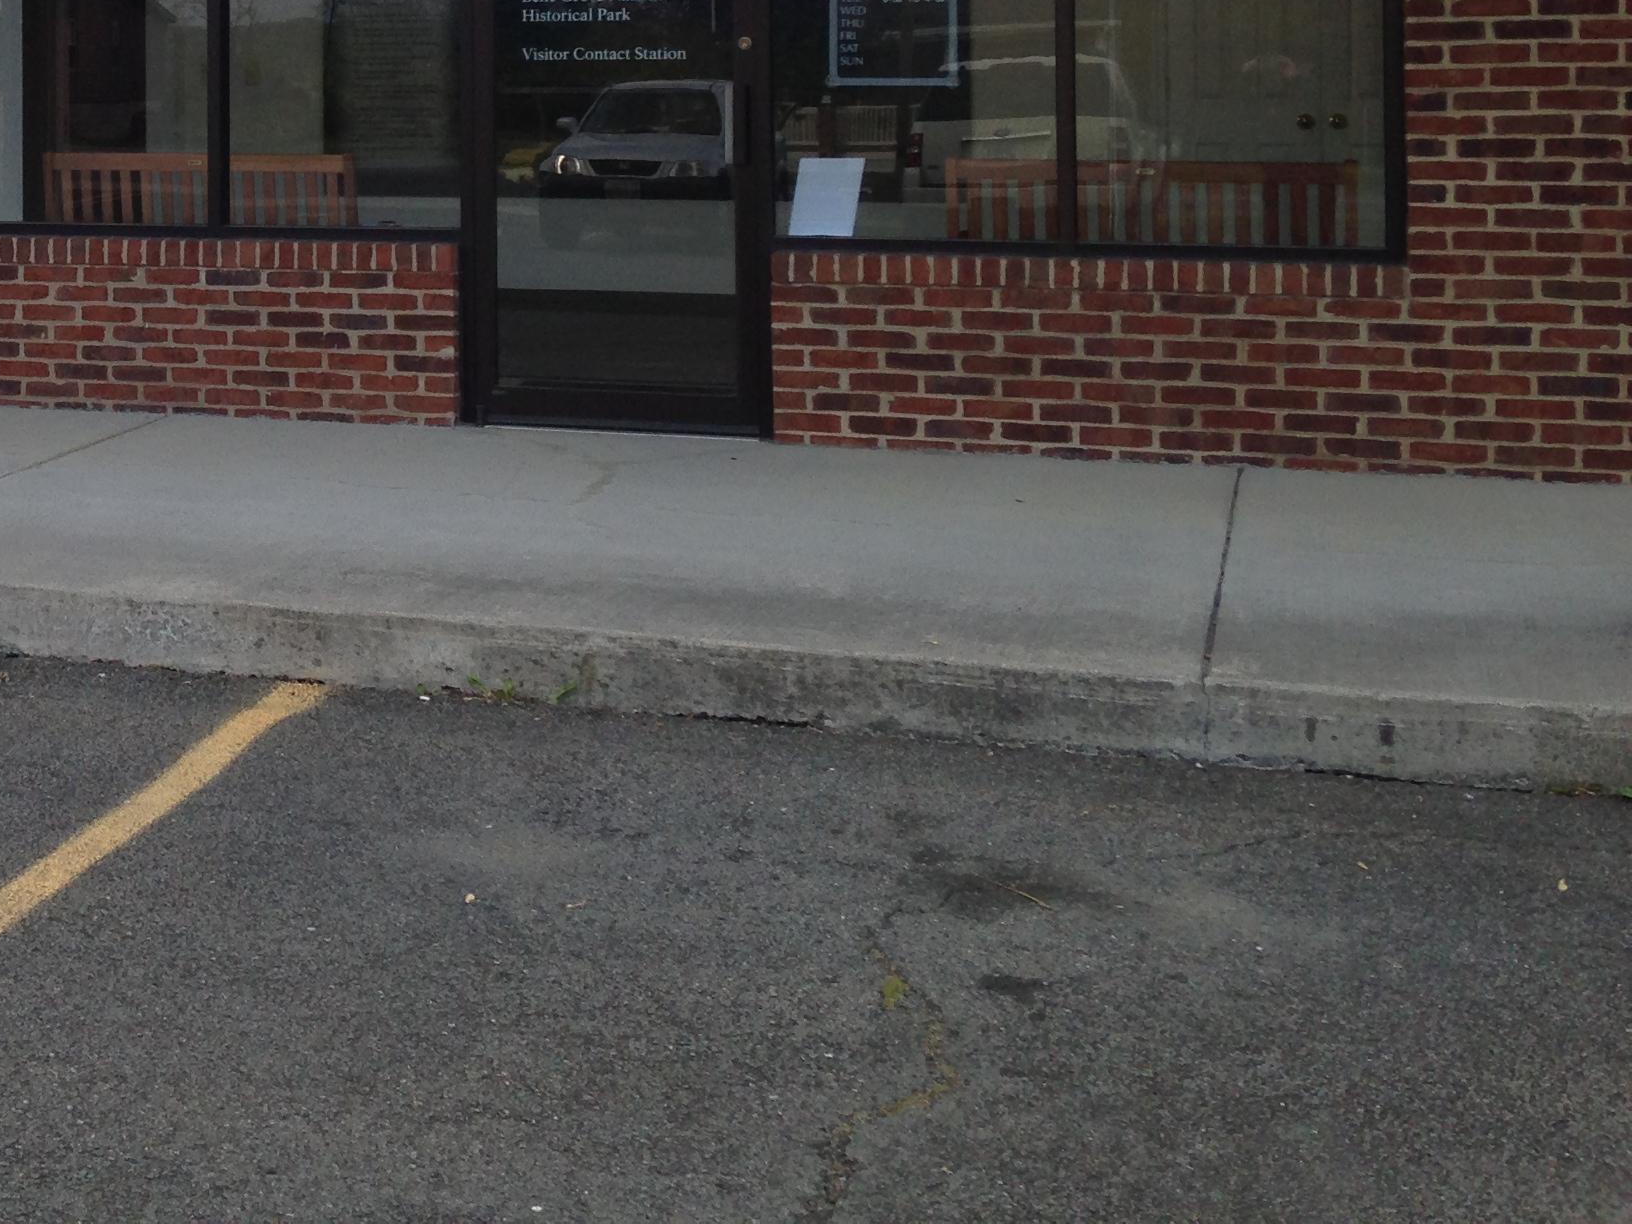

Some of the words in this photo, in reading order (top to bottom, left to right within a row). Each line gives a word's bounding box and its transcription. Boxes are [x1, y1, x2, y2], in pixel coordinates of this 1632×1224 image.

[521, 8, 593, 23] Historical
[597, 7, 631, 22] Park
[840, 6, 867, 15] WED
[840, 19, 864, 28] THU
[839, 31, 857, 41] FRI
[521, 47, 569, 61] Visitor
[573, 46, 631, 61] Contact
[635, 46, 687, 60] Station
[839, 44, 859, 53] SAT
[839, 56, 864, 66] SUN
